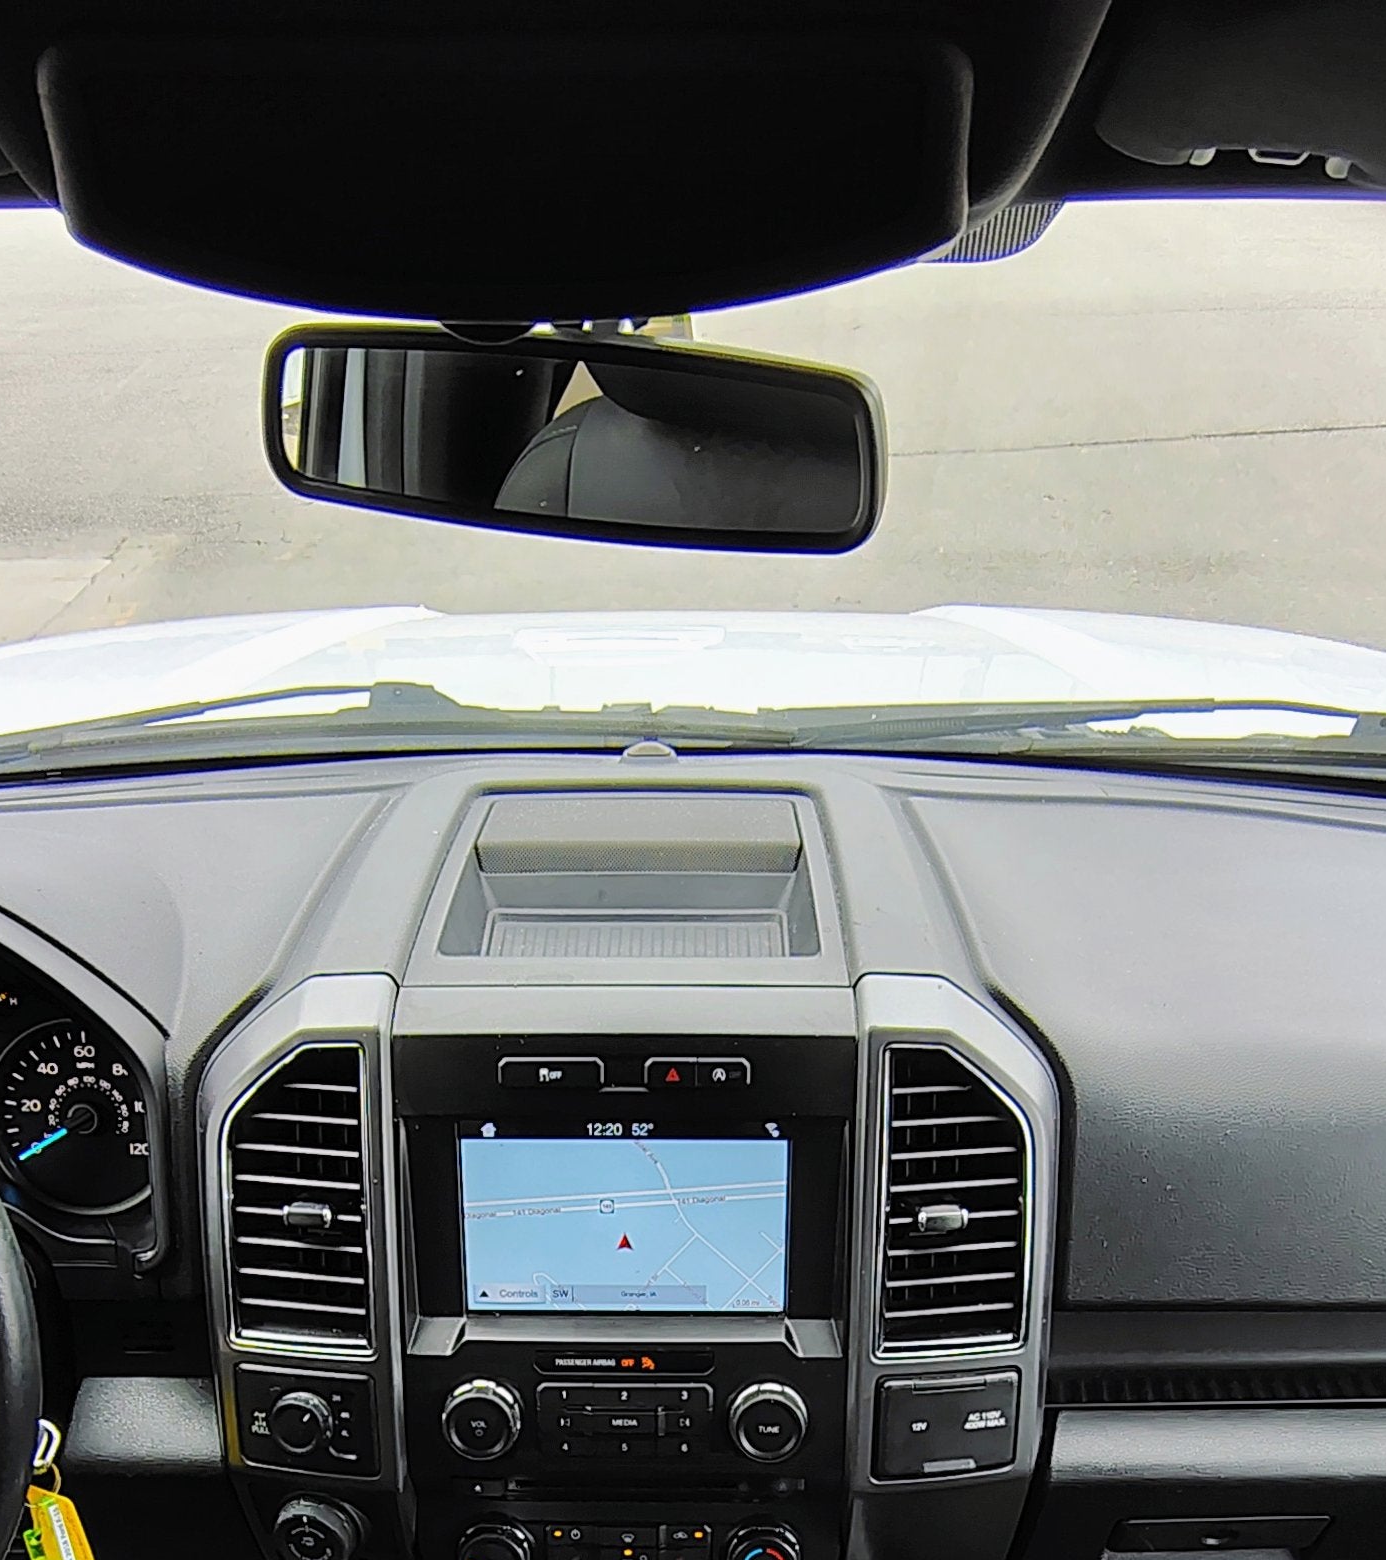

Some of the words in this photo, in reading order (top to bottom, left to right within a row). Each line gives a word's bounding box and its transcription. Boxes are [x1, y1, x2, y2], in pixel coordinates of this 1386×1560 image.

[73, 1045, 95, 1058] 60
[37, 1062, 59, 1075] 40
[21, 1099, 42, 1112] 20
[586, 1122, 623, 1137] 12:20
[631, 1122, 654, 1136] 52°
[693, 1195, 726, 1205] Diagonal
[528, 1206, 562, 1216] Diagonal
[499, 1289, 539, 1299] Controls
[552, 1289, 569, 1298] SW
[621, 1358, 635, 1367] OFF
[562, 1390, 567, 1400] 1
[621, 1390, 628, 1401] 2
[681, 1390, 689, 1400] 3
[470, 1420, 488, 1428] VOL
[611, 1418, 638, 1427] MEDIA
[912, 1422, 928, 1432] 12V
[758, 1426, 780, 1434] TUNE
[562, 1443, 569, 1451] 4
[621, 1443, 628, 1452] 5
[681, 1443, 688, 1452] 6
